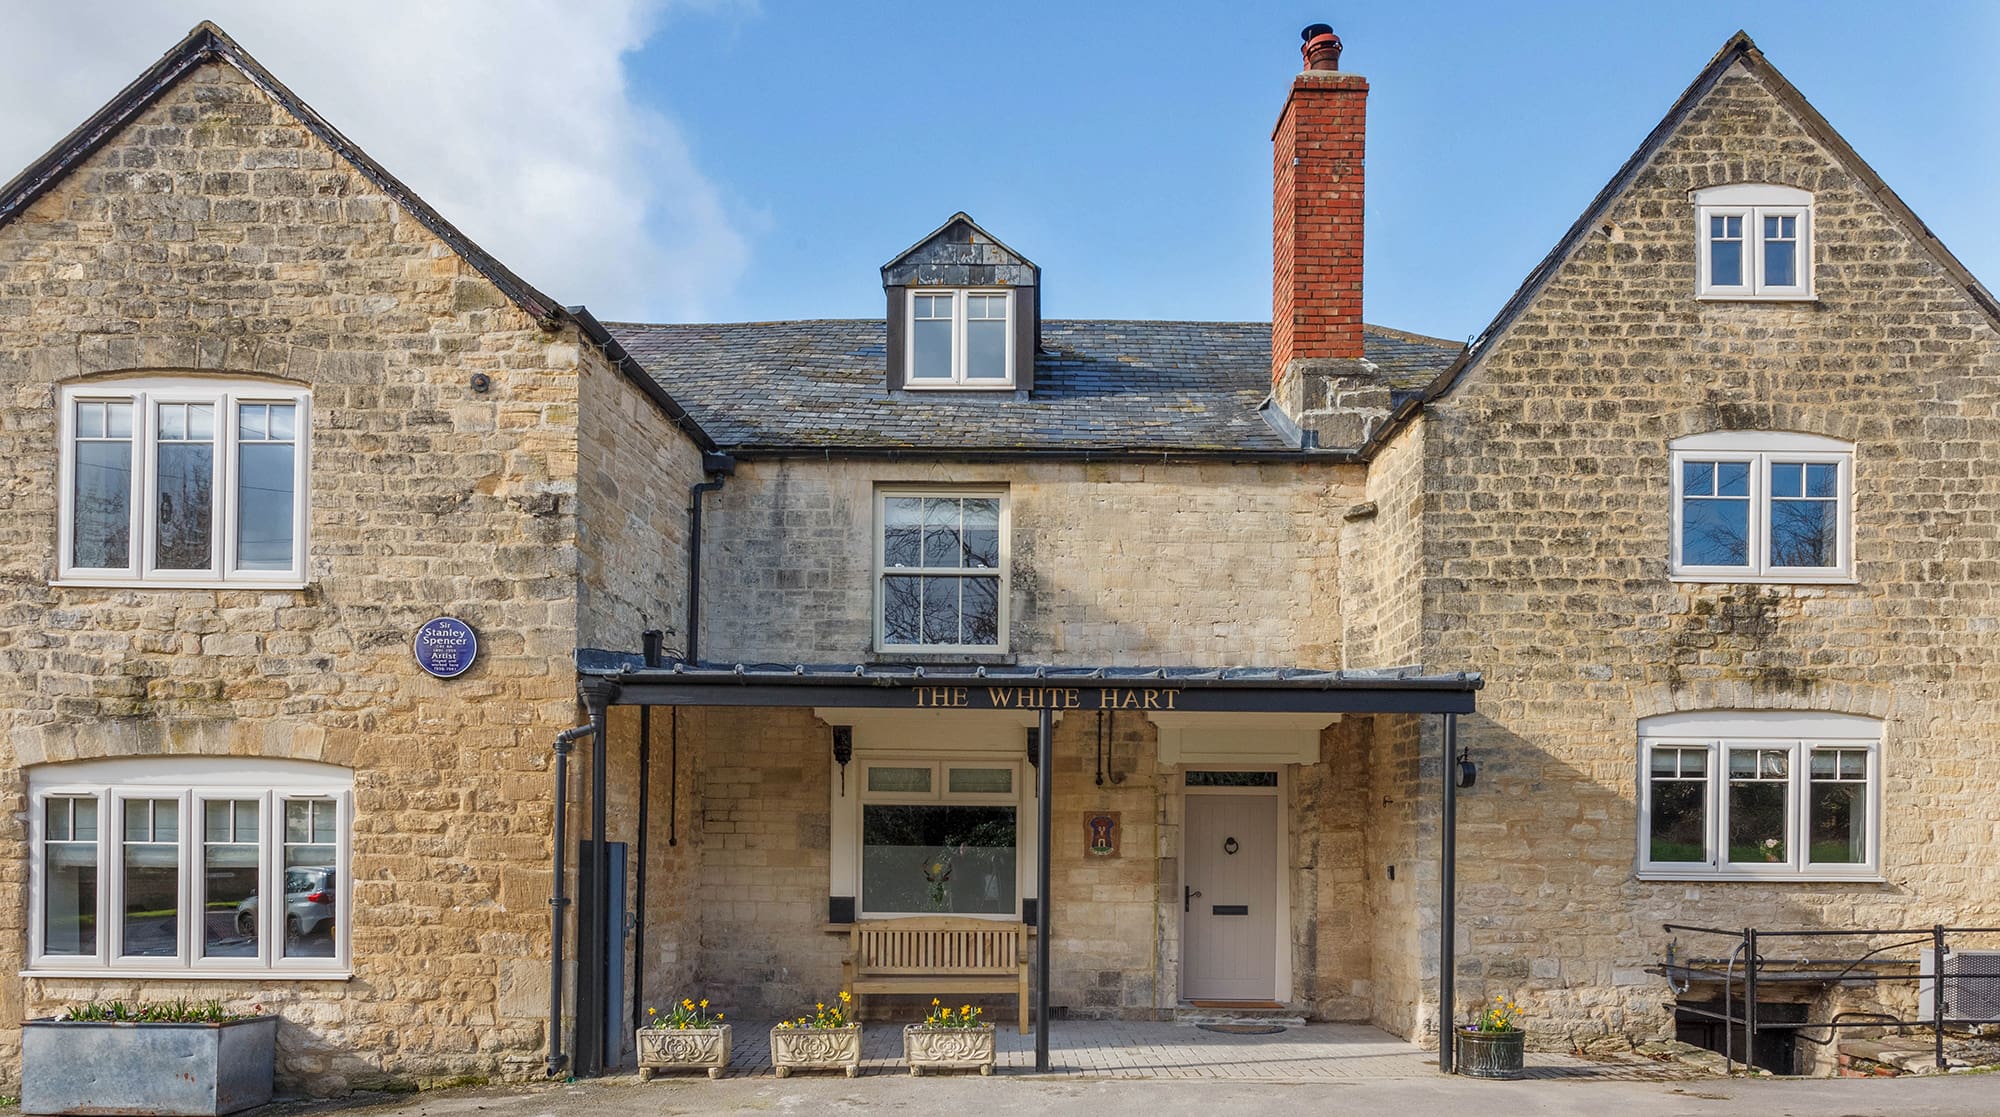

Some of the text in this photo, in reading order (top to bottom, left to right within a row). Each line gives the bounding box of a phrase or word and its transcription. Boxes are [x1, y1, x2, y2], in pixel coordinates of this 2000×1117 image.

[425, 628, 465, 638] Stanley
[423, 637, 467, 646] Spencer
[912, 687, 1181, 709] THE WHITE HART
